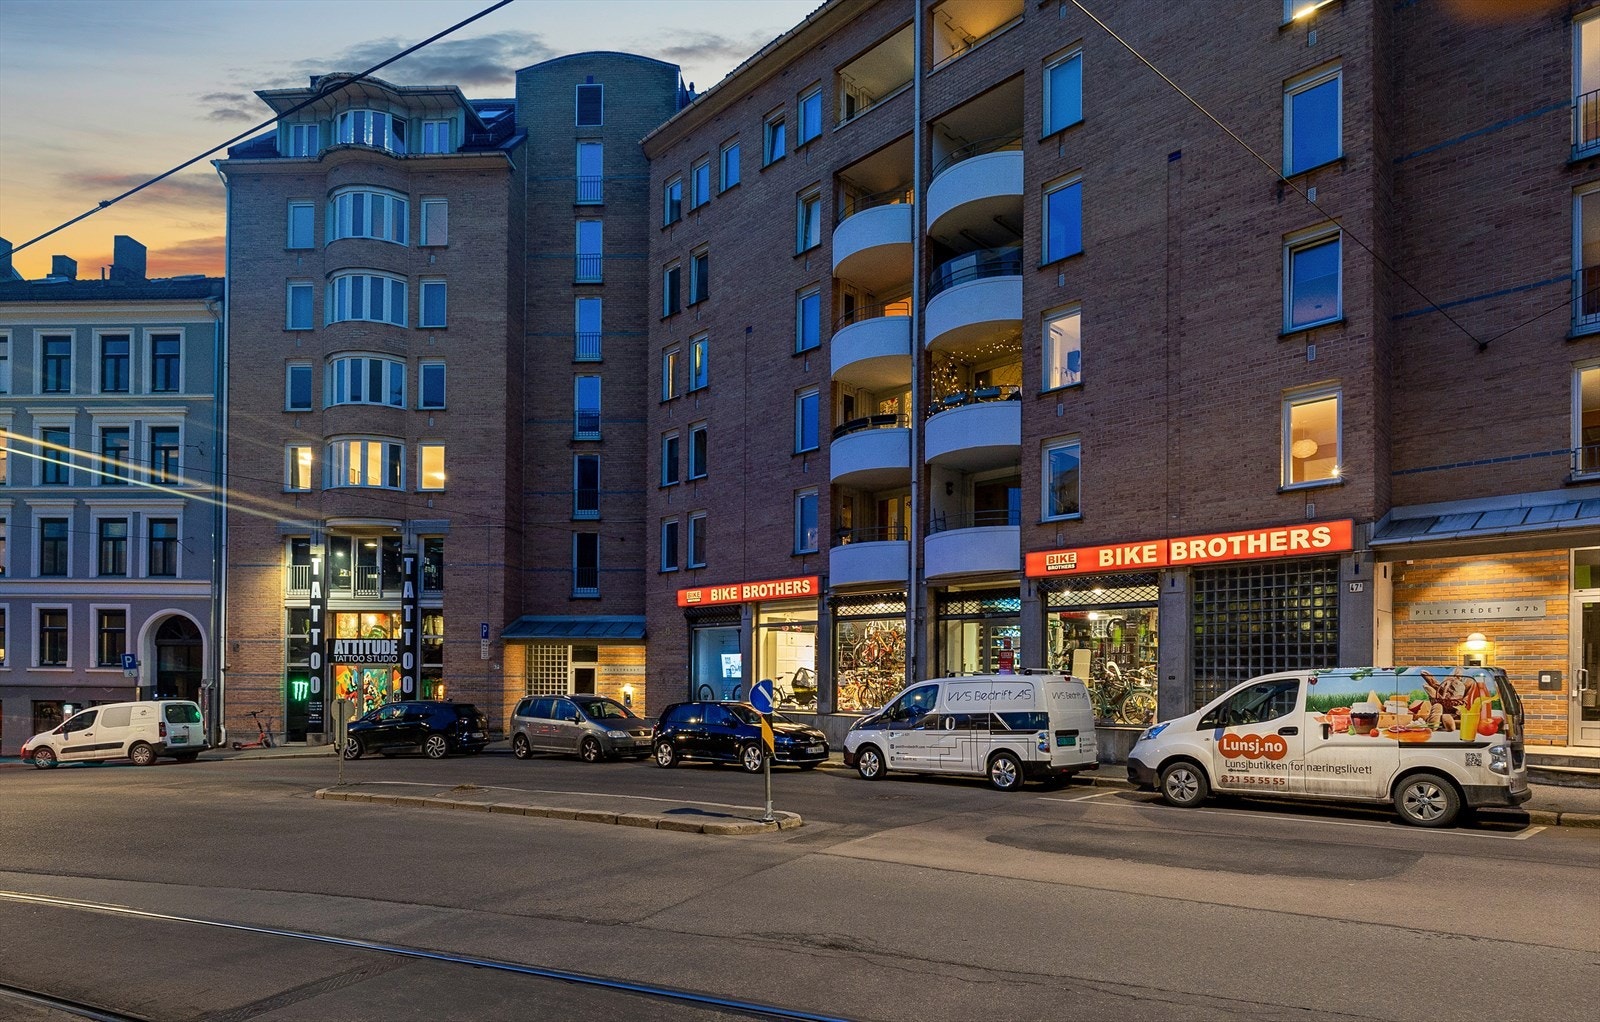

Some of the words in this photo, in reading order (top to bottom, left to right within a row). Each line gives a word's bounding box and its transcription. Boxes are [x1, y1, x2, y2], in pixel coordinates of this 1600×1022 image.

[1098, 544, 1157, 567] BIKE
[1171, 526, 1332, 561] BROTHERS
[1048, 554, 1075, 564] BIKE
[1047, 563, 1075, 571] BROTHERS
[687, 591, 701, 599] BIKE
[710, 587, 738, 601] BIKE
[743, 580, 811, 599] BROTHERS
[1415, 607, 1501, 616] PILESTREDET
[310, 557, 322, 694] TATTOO
[402, 557, 414, 694] TATTOO
[333, 640, 398, 655] ATTITUDE
[124, 655, 133, 668] P
[333, 654, 365, 663] TATTOO
[366, 654, 398, 663] STUDIO
[974, 690, 1013, 701] Bedrift
[1013, 688, 1032, 701] AS
[1223, 738, 1283, 755] Lunsj.no
[1225, 759, 1288, 771] Lunsjbutikken
[1290, 761, 1304, 772] for
[1307, 763, 1372, 775] næringslivet!
[1229, 775, 1240, 783] 21
[1243, 776, 1256, 784] 55
[1258, 776, 1270, 785] 55
[1272, 777, 1285, 786] 55
